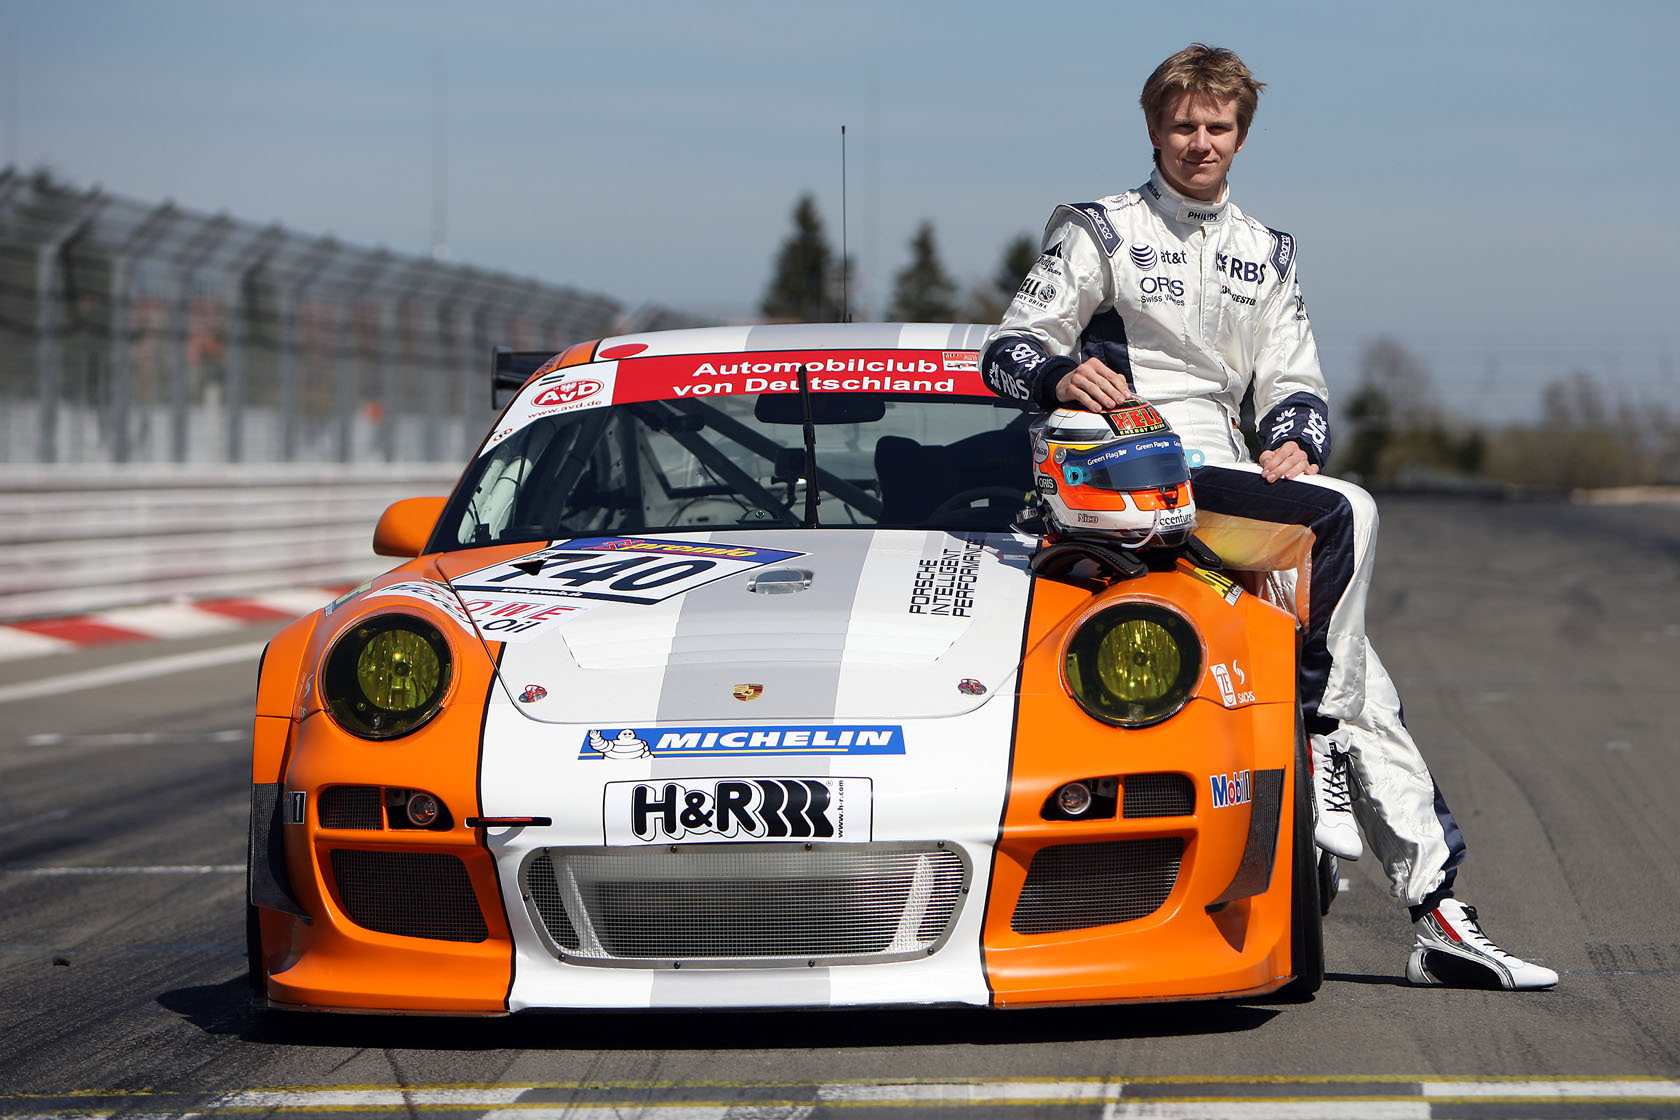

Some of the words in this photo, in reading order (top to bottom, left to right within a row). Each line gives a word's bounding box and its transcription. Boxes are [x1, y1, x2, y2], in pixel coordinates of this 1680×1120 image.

[1084, 207, 1113, 241] sparco
[1188, 211, 1218, 221] PHILIPS
[1161, 250, 1187, 264] at&t
[1230, 257, 1266, 285] RBS
[1140, 295, 1163, 304] Swiss
[692, 359, 938, 376] Automobilclub
[538, 382, 600, 405] AvD
[672, 383, 733, 397] von
[744, 377, 955, 394] Deutschland
[1000, 369, 1030, 401] RBS
[528, 400, 602, 419] www.avd.de
[1110, 407, 1163, 430] HELL
[1136, 443, 1154, 451] Green
[1154, 441, 1164, 449] Flag
[1087, 454, 1105, 465] Green
[1105, 451, 1118, 460] Flag
[1039, 477, 1054, 489] ORIS
[1159, 513, 1192, 526] ccenture
[485, 552, 717, 592] 740
[952, 538, 984, 617] PERFORMANCE
[909, 559, 938, 614] PORSCHE
[931, 548, 961, 616] INTELLIGENT
[482, 619, 541, 633] Oil
[655, 730, 893, 749] MICHELIN
[632, 781, 760, 838] H&R
